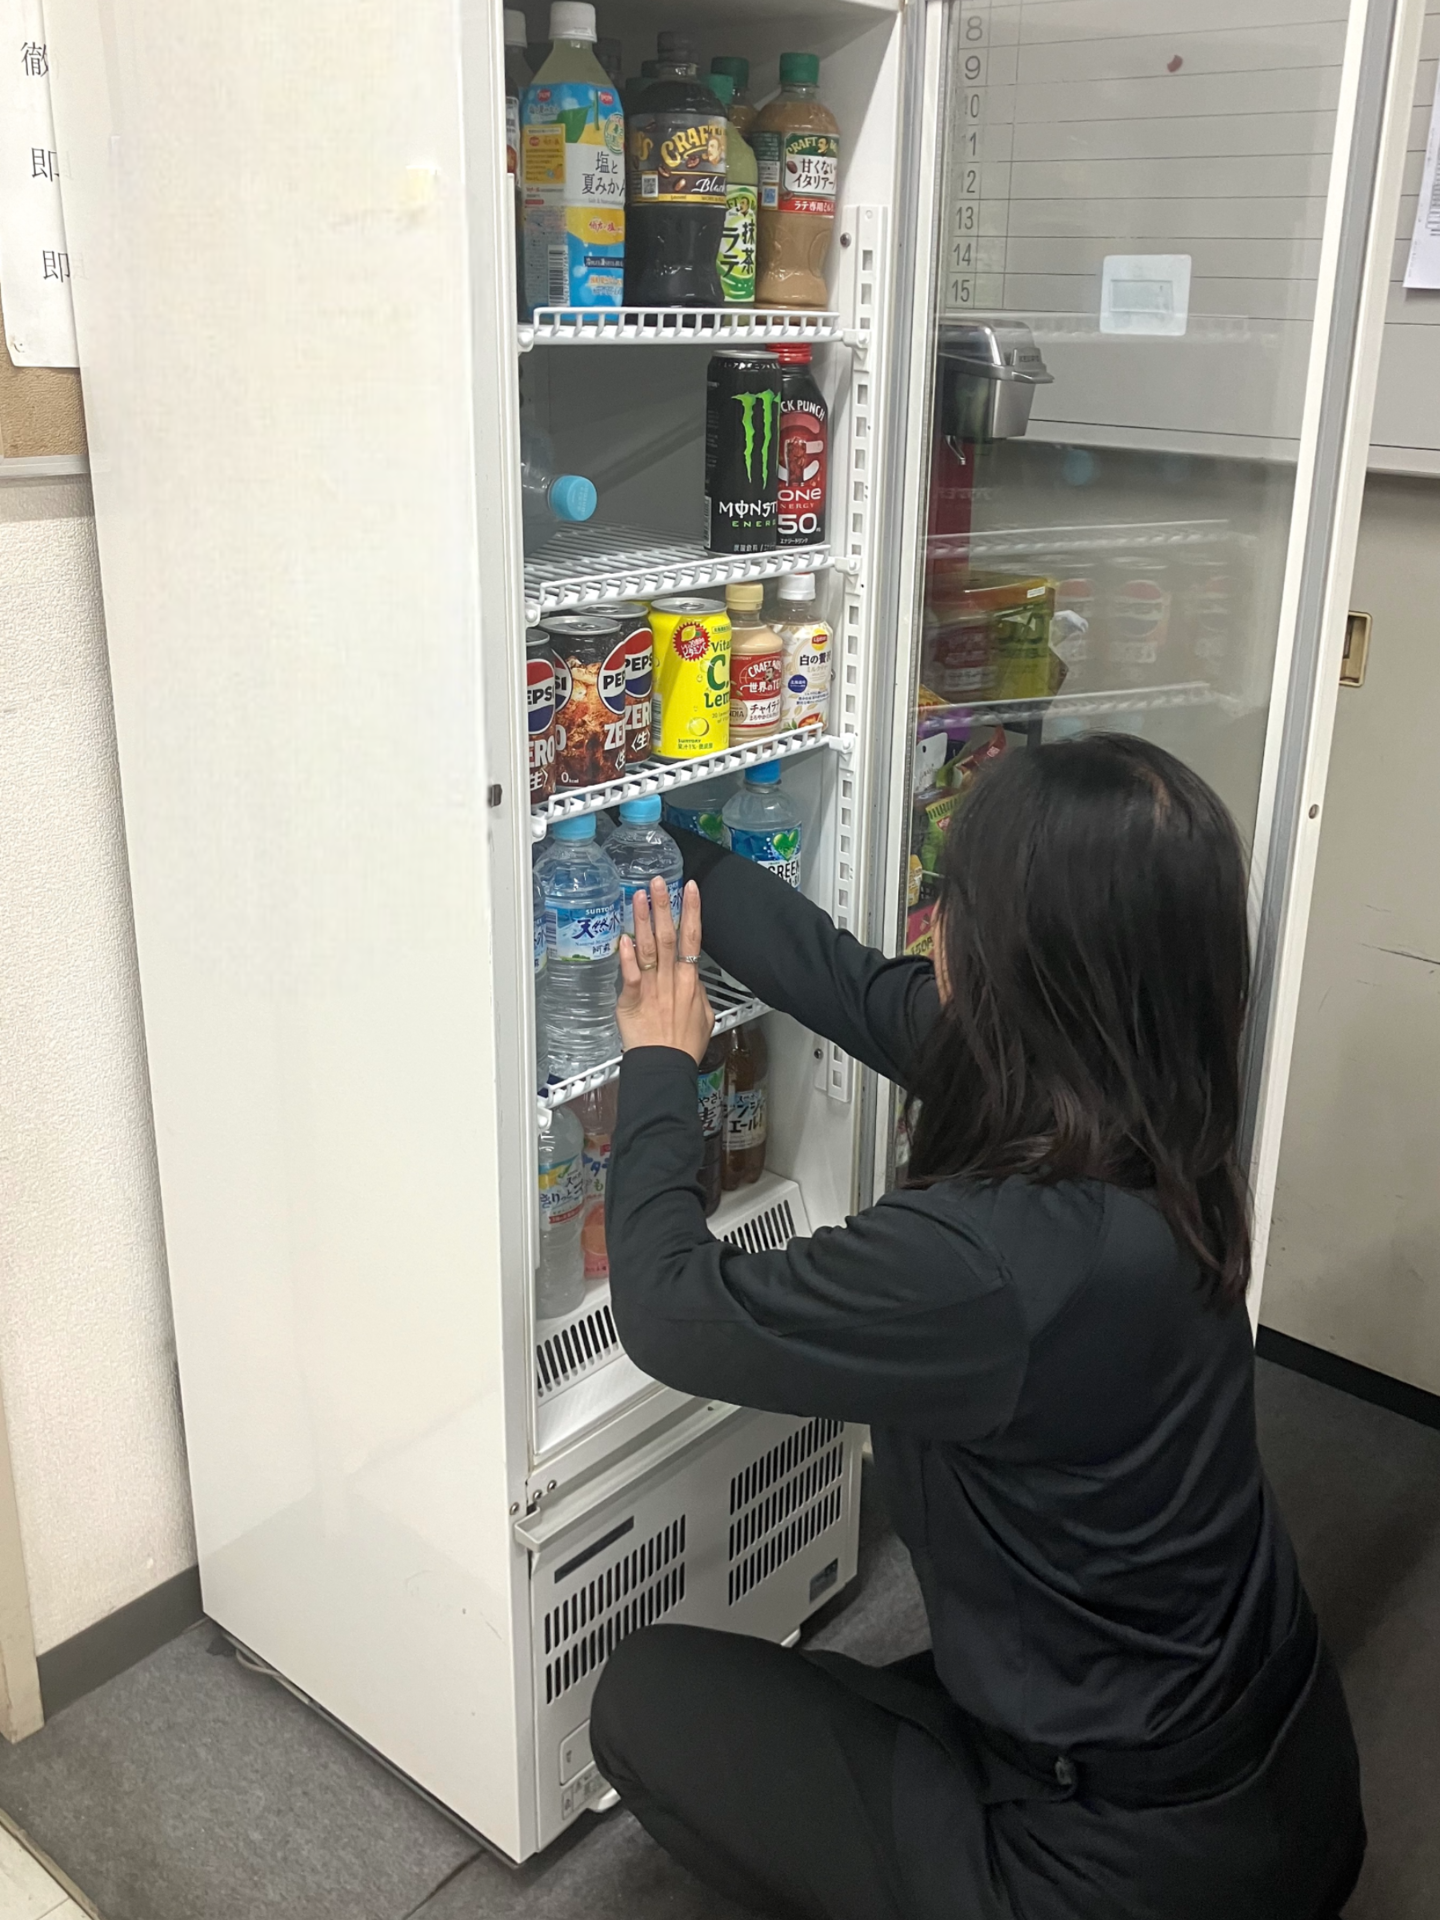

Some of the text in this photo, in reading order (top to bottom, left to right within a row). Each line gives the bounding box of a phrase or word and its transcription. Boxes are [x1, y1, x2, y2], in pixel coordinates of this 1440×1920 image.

[966, 15, 983, 41] 8
[965, 55, 981, 80] 9
[31, 147, 60, 182] 即
[595, 151, 618, 175] 塩と
[956, 206, 974, 230] 13
[720, 227, 741, 278] ラテ
[740, 220, 755, 275] 抹茶
[953, 243, 971, 266] 14
[42, 250, 70, 283] 即
[951, 280, 970, 303] 15
[797, 400, 826, 422] PUNCH
[719, 500, 778, 518] MONST
[780, 502, 815, 510] NERGY
[625, 701, 653, 731] ZER
[528, 735, 555, 768] ERO
[572, 912, 621, 940] 天然水
[699, 1106, 718, 1132] 麦
